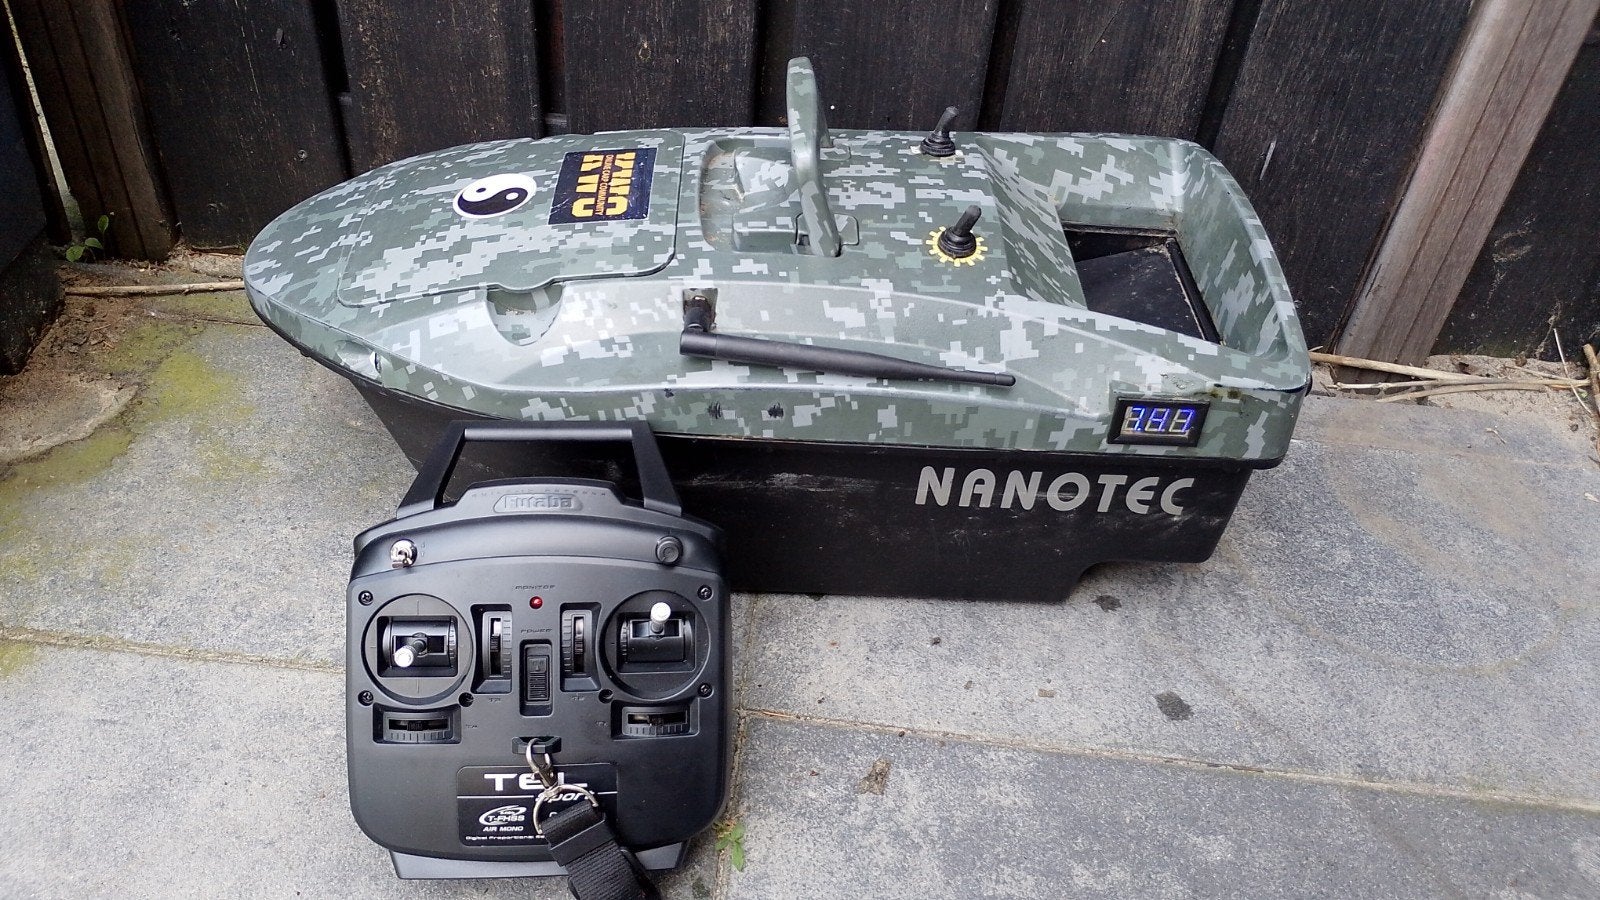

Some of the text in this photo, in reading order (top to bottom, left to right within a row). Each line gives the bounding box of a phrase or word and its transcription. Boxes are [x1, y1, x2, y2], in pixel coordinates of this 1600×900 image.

[595, 154, 614, 215] ONLINE CARP COMMUNITY
[914, 465, 1195, 516] NANOTEC
[487, 814, 526, 822] T-FHSS
